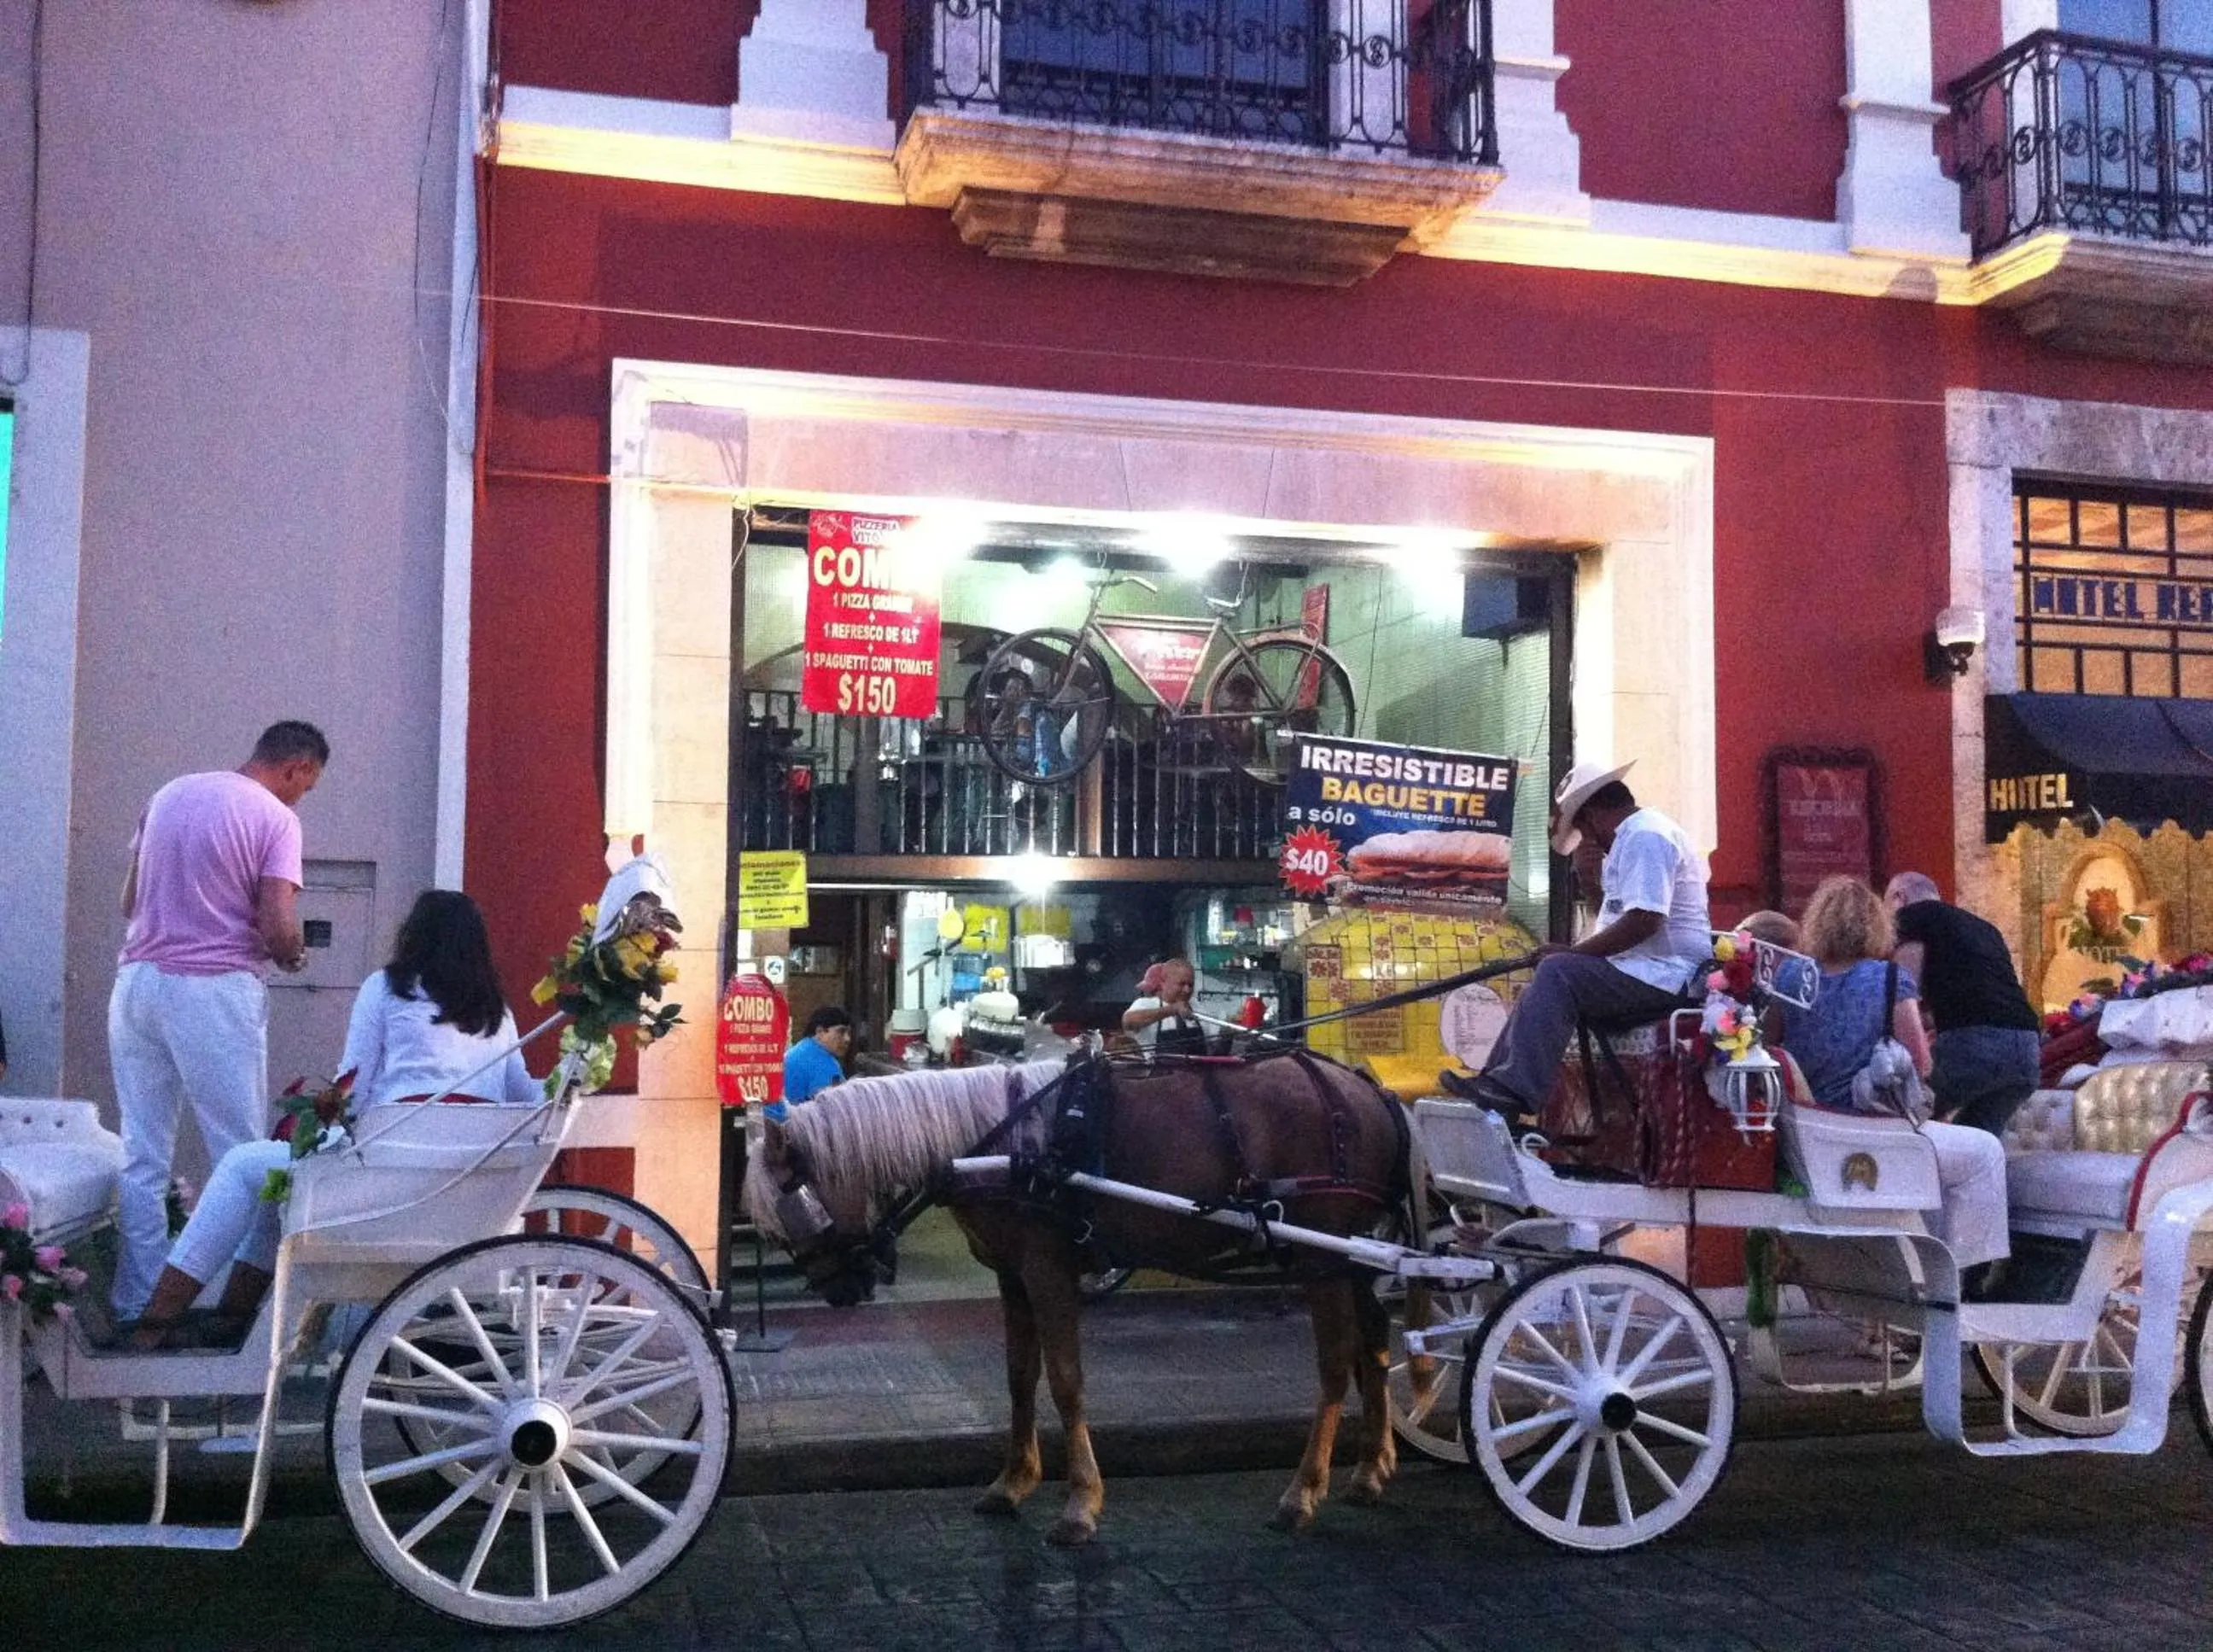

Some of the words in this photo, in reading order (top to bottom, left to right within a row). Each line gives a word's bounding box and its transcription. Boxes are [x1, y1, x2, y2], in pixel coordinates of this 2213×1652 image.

[833, 592, 839, 608] 1
[841, 593, 870, 609] PIZZA
[823, 622, 829, 638] 1
[832, 623, 883, 641] REFRESCO
[885, 626, 899, 642] DE
[805, 651, 810, 668] 1
[813, 652, 868, 670] SPAGUETTI
[871, 657, 891, 673] CON
[894, 657, 933, 676] TOMATE
[837, 672, 896, 714] $150
[1300, 744, 1510, 791] IRRESISTIBLE
[1321, 777, 1486, 817] BAGUETTE
[1288, 805, 1301, 820] a
[1308, 805, 1356, 826] sólo
[1286, 847, 1328, 876] $40
[724, 995, 775, 1021] COMBO
